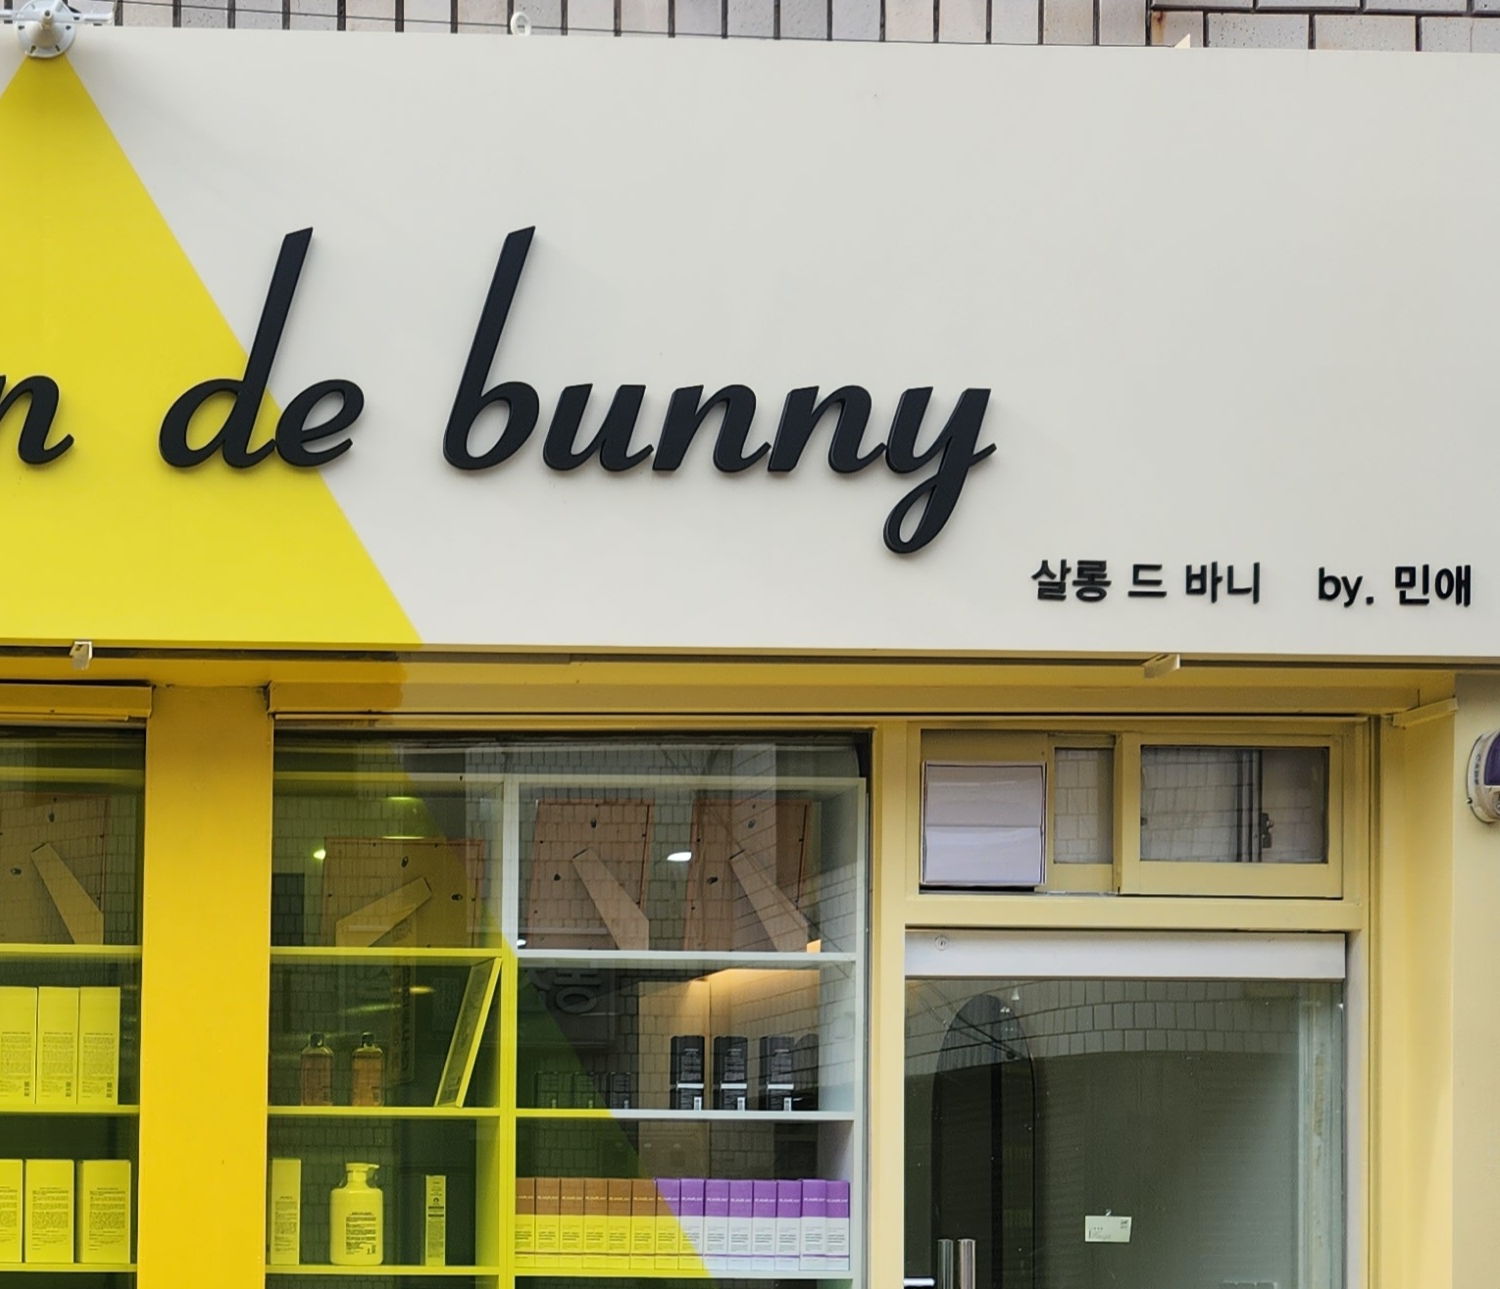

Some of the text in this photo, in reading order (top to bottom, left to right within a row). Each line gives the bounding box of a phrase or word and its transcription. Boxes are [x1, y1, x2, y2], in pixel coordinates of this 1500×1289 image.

[159, 228, 364, 470] de
[443, 227, 996, 556] bunny
[1031, 559, 1471, 607] 살롱 드 바니 by. 민애
